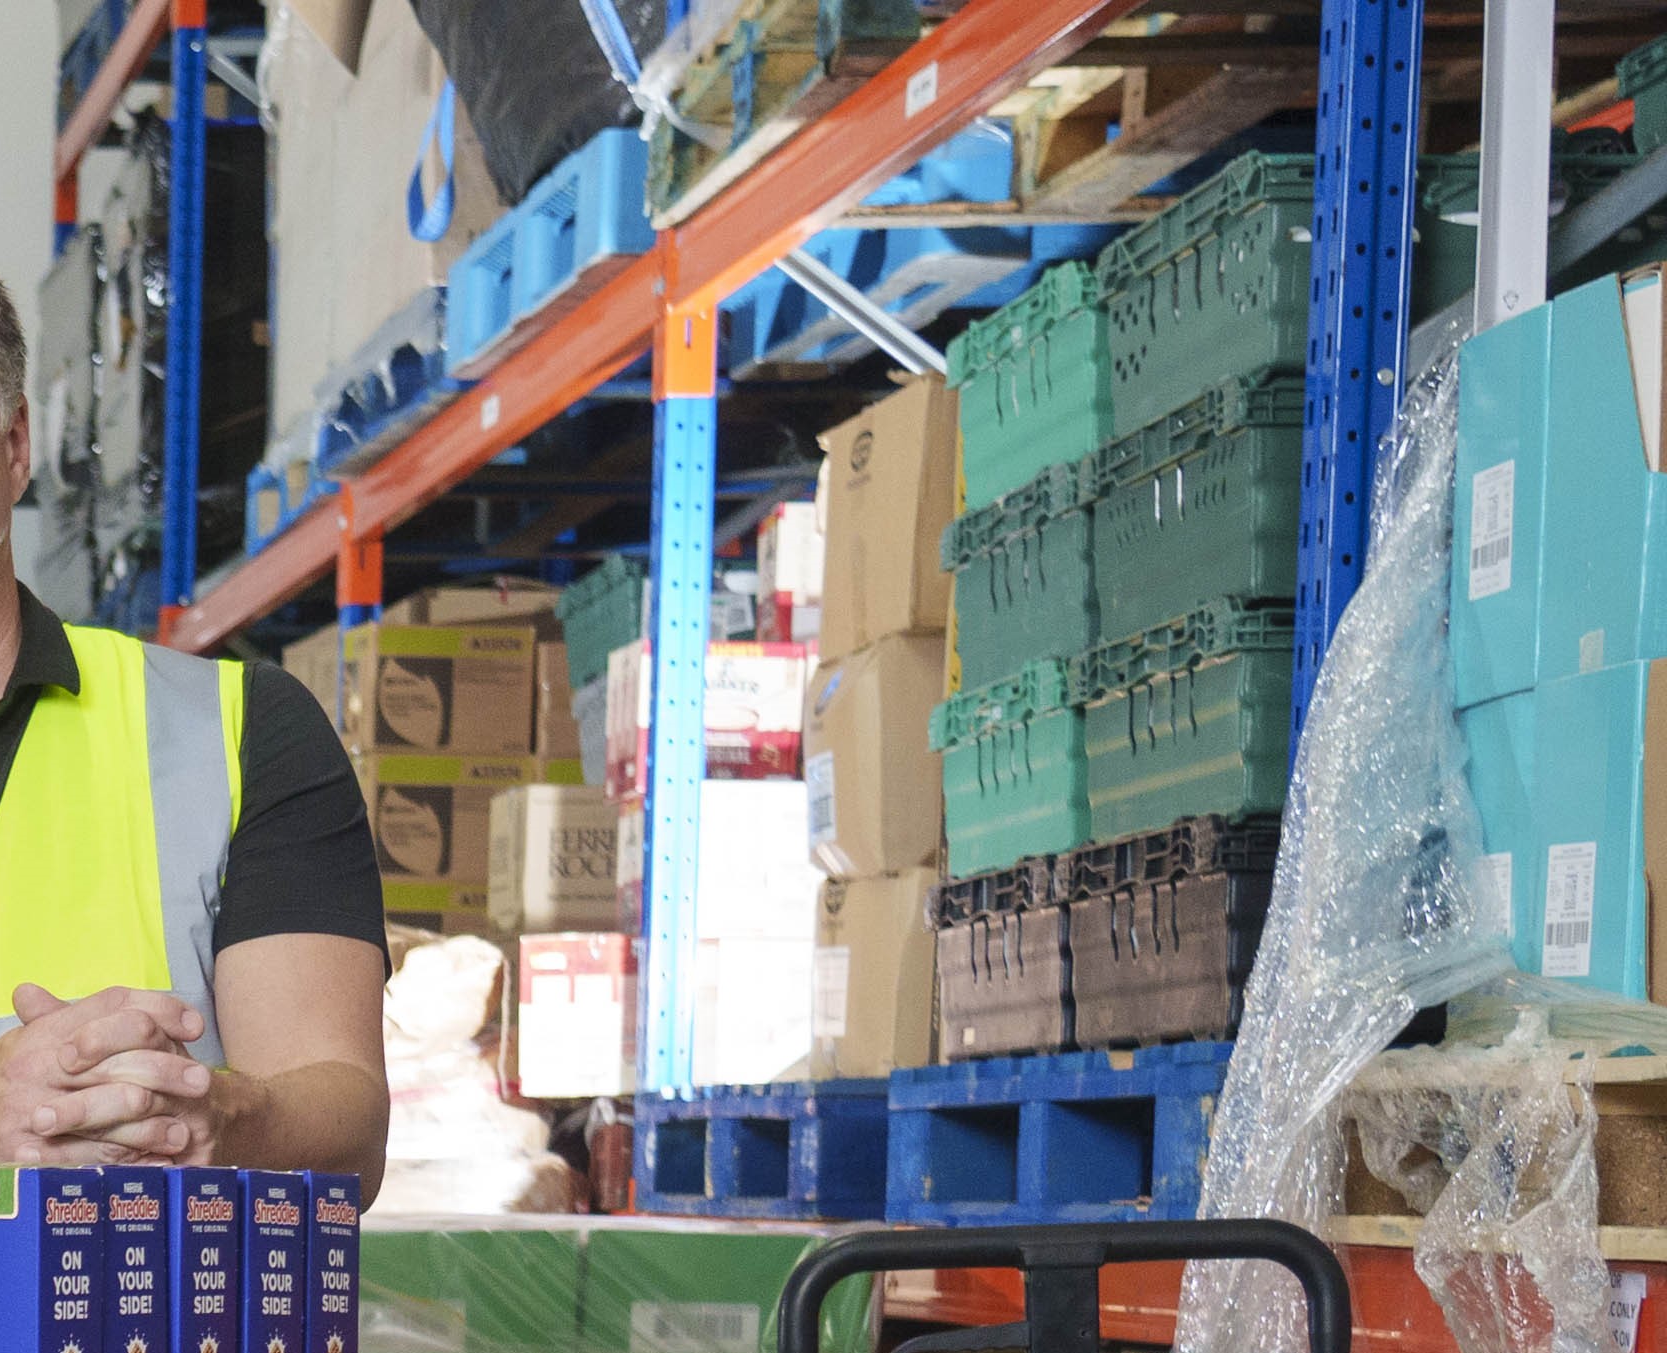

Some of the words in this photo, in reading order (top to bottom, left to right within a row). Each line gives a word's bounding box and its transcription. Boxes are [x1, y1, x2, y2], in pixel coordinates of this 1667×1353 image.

[46, 1197, 98, 1224] Shreddies
[109, 1194, 159, 1220] Shreddies
[62, 1251, 82, 1270] ON
[125, 1247, 145, 1265] ON
[201, 1248, 218, 1266] ON
[268, 1250, 286, 1268] ON
[328, 1249, 344, 1267] ON
[53, 1276, 90, 1295] YOUR
[118, 1271, 153, 1290] YOUR
[193, 1272, 225, 1290] YOUR
[261, 1274, 292, 1292] YOUR
[321, 1272, 350, 1290] YOUR
[54, 1300, 88, 1320] SIDE!
[119, 1296, 152, 1315] SIDE!
[194, 1295, 224, 1314] SIDE!
[262, 1297, 291, 1315] SIDE!
[322, 1295, 348, 1313] SIDE!
